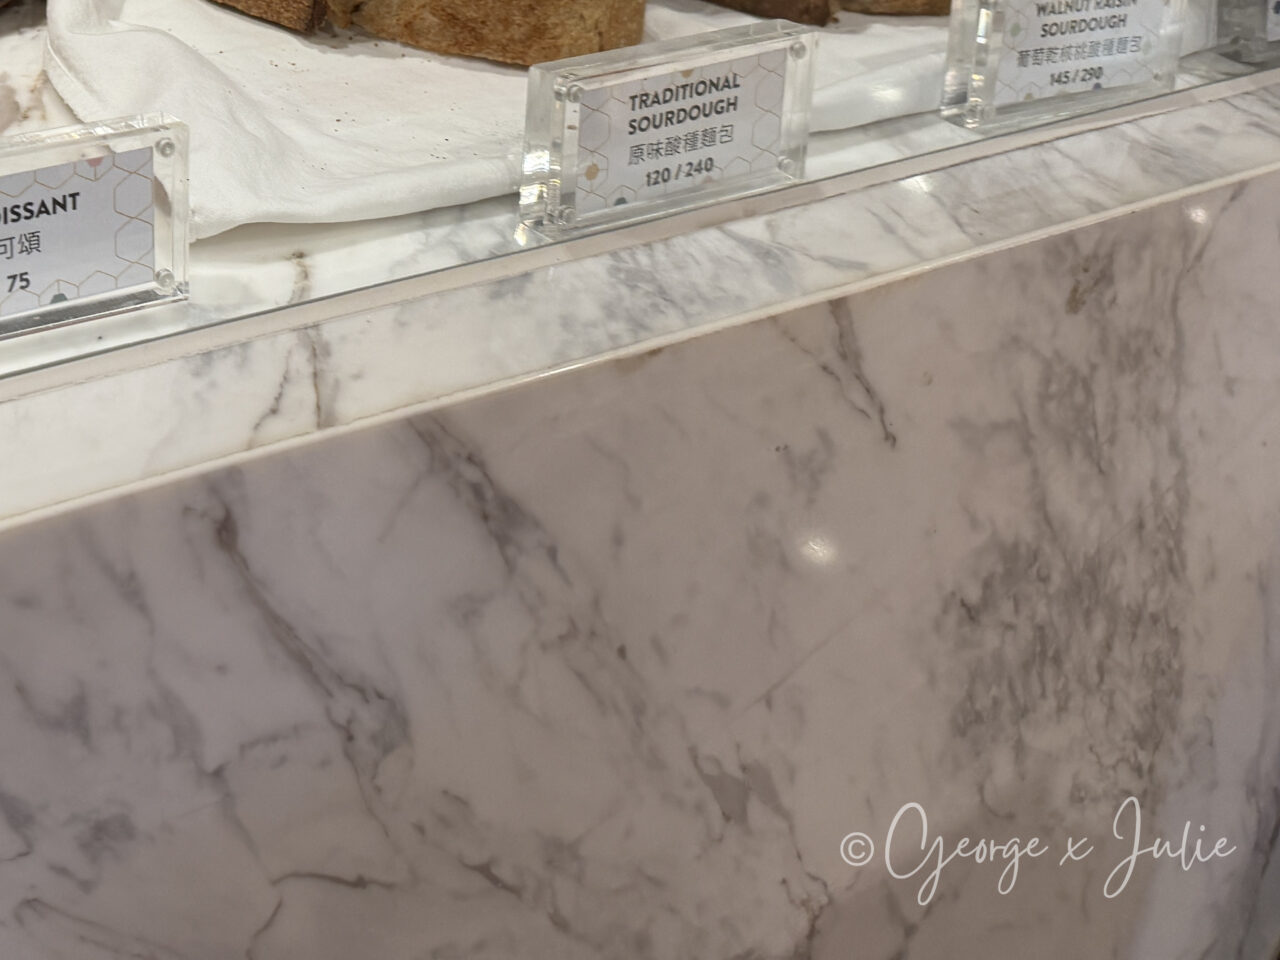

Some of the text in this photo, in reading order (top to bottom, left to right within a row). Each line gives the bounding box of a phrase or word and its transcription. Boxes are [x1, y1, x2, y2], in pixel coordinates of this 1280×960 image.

[1041, 14, 1127, 38] SOURDOUGH
[1050, 70, 1070, 86] 145
[1081, 66, 1104, 83] 290
[628, 73, 740, 111] TRADITIONAL
[628, 96, 738, 135] SOURDOUGH
[628, 124, 735, 166] 原味酸種麵包
[646, 167, 671, 187] 120
[685, 157, 715, 177] 240
[7, 272, 31, 292] 75
